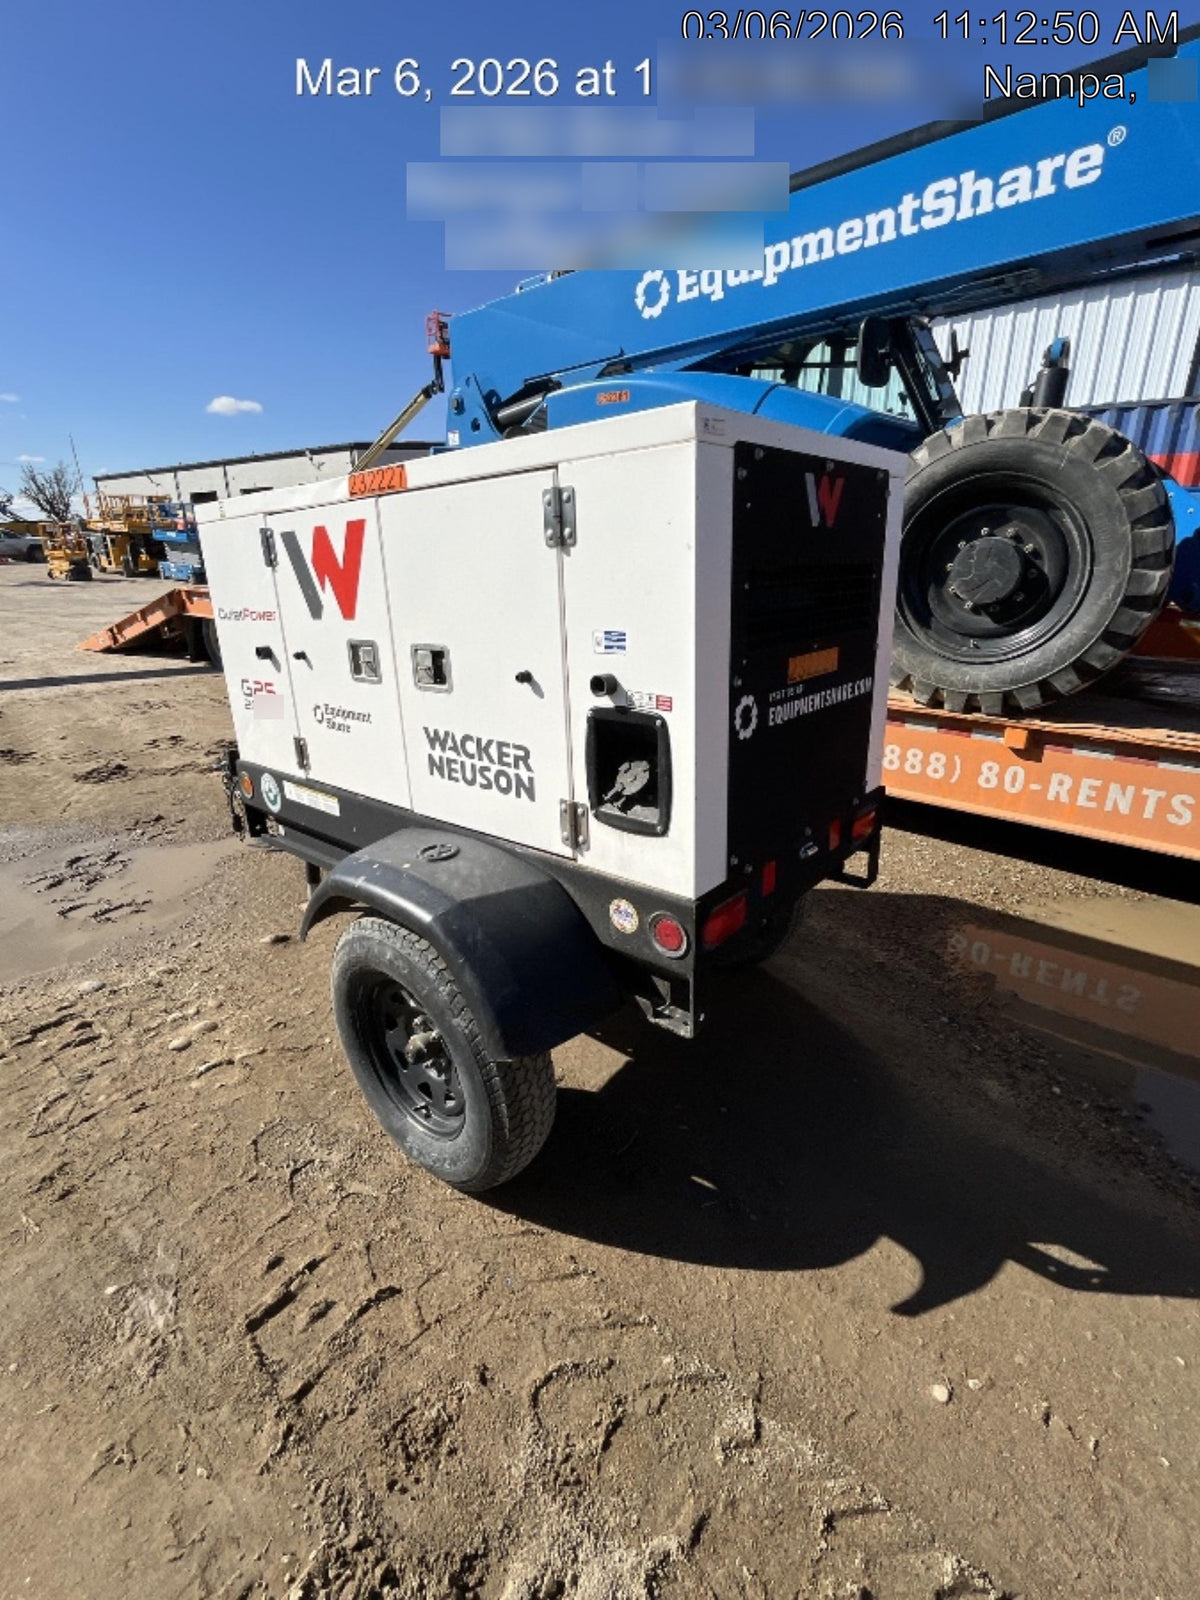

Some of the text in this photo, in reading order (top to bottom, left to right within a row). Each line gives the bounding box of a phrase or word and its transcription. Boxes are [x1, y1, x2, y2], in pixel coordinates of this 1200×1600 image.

[767, 677, 873, 727] EQUIPMENTSHARE.COM
[422, 726, 535, 774] WACKER
[428, 753, 536, 803] NEUSON
[977, 760, 1196, 827] 80-RENTS
